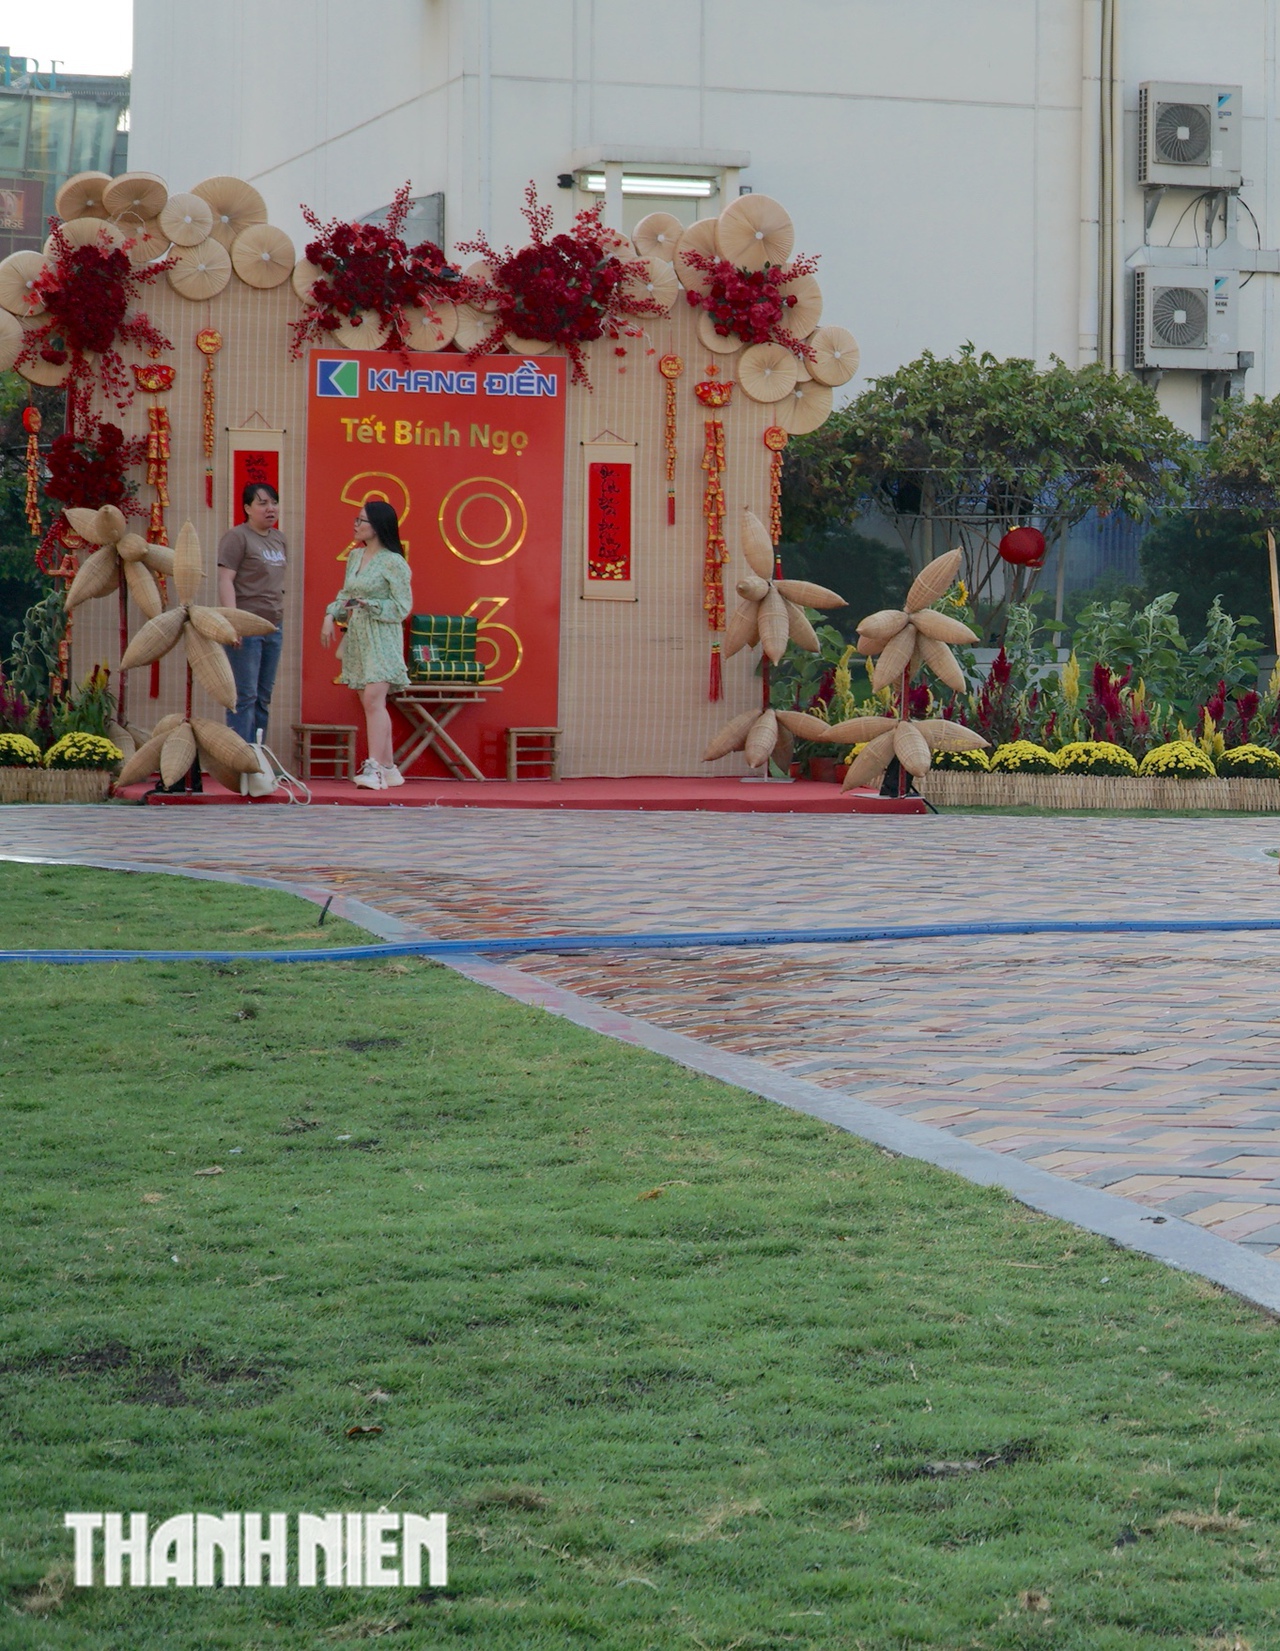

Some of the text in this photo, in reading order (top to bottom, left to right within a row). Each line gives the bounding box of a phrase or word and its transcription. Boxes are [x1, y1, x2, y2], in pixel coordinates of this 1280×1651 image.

[368, 360, 557, 397] KHANG ĐIỀN
[340, 414, 528, 456] Tết Bính Ngọ
